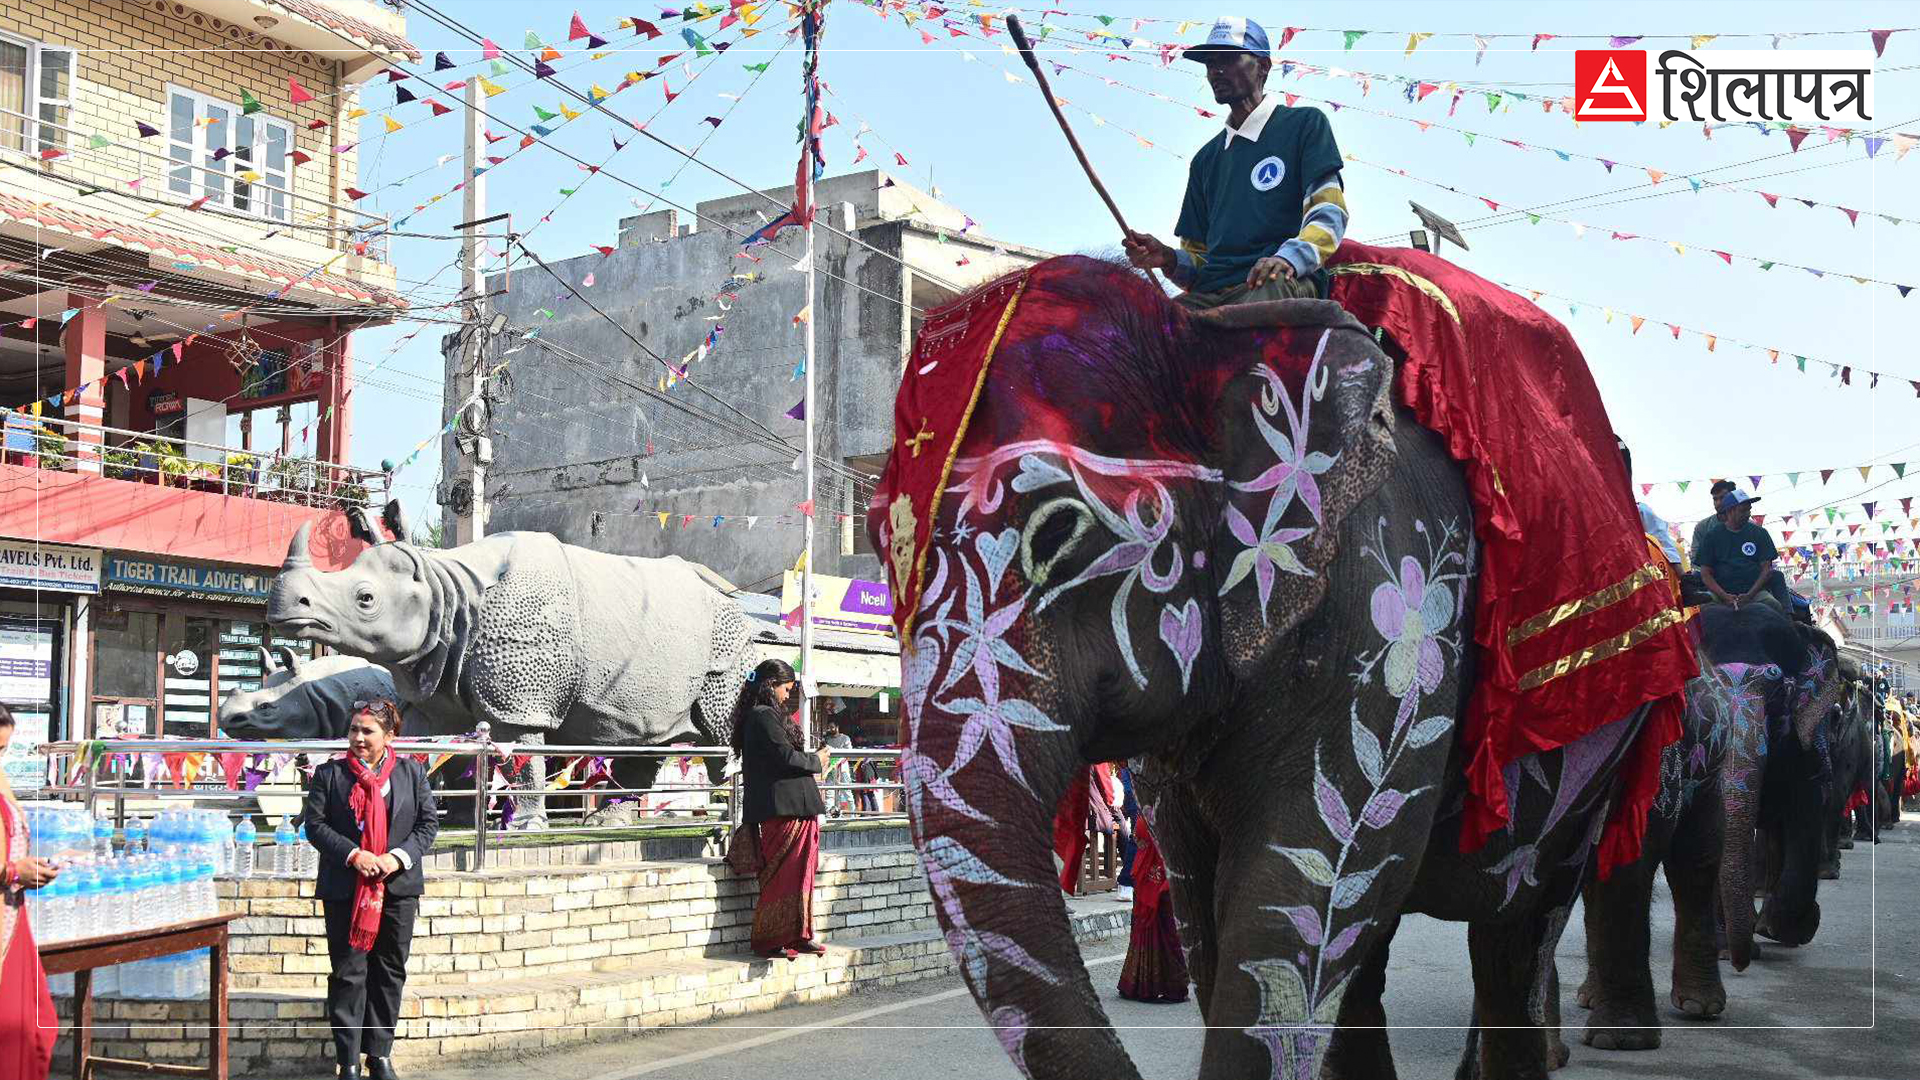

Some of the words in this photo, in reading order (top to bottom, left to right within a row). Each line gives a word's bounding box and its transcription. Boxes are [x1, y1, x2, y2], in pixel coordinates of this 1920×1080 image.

[0, 548, 40, 567] AVELS
[44, 552, 66, 569] Pvt.
[71, 555, 93, 572] Ltd.
[113, 559, 155, 582] TIGER
[158, 564, 200, 587] TRAIL
[861, 591, 886, 606] Ncell
